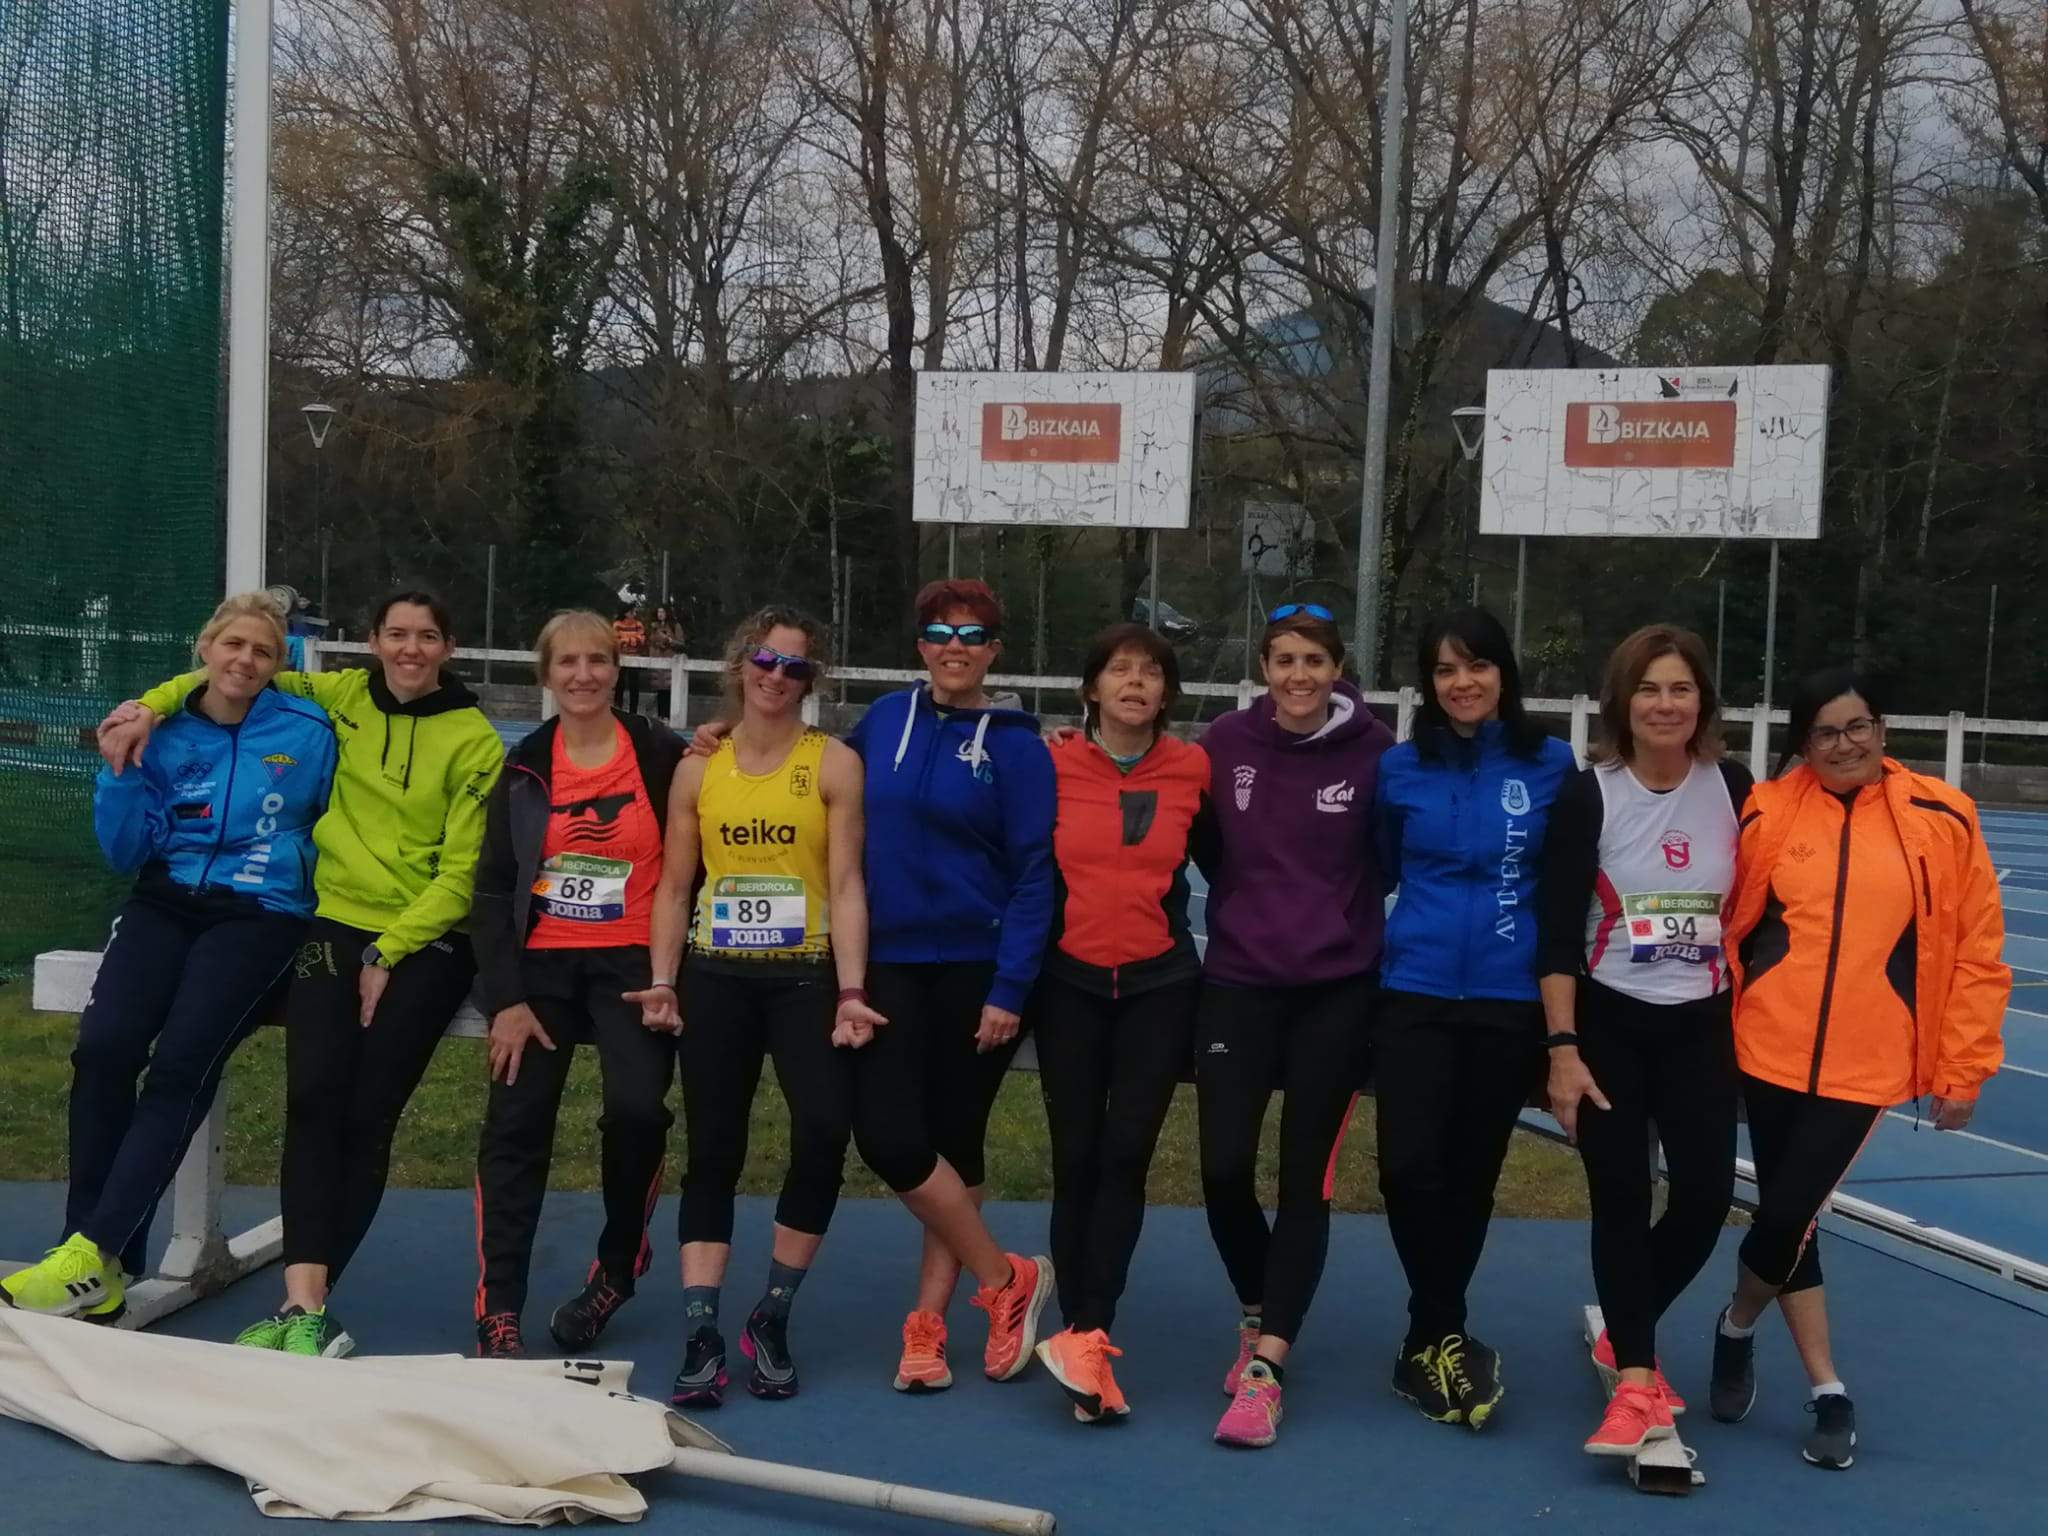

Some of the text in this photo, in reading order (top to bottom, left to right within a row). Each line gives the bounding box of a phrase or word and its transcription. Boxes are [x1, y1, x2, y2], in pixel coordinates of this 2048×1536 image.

[1028, 419, 1101, 436] BIZKAIA
[1621, 420, 1710, 439] BIZKAIA
[719, 818, 796, 846] teika
[563, 861, 620, 875] IBERDROLA
[560, 877, 594, 901] 68
[736, 883, 795, 893] IBERDROLA
[738, 900, 771, 923] 89
[1661, 899, 1715, 910] IBERDROLA
[1663, 916, 1697, 940] 94
